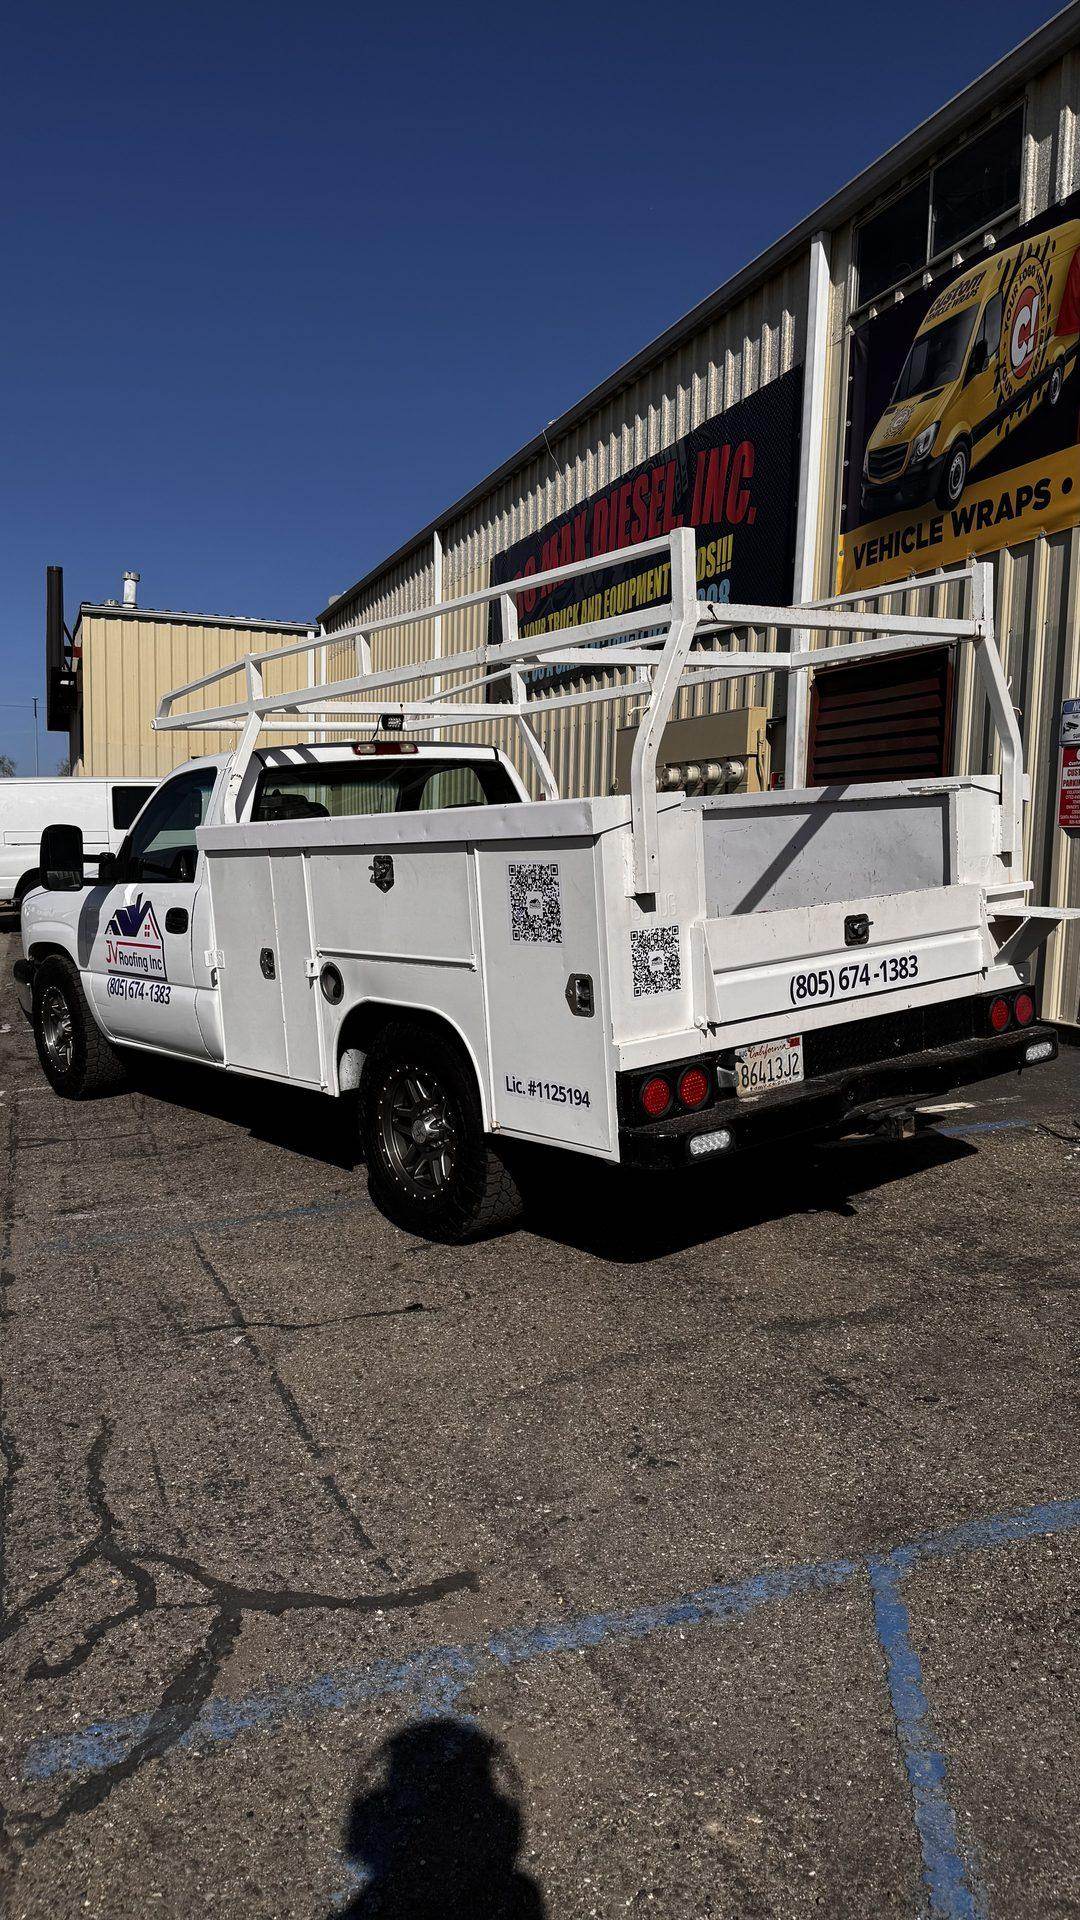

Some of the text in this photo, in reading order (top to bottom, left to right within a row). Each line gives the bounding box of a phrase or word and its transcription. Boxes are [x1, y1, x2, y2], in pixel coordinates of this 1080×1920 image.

[1004, 284, 1019, 332] YOUR
[1019, 264, 1036, 286] LOGO
[541, 508, 588, 597] MAX
[690, 440, 757, 526] INC.
[853, 476, 1052, 570] VEHICLE WRAPS
[547, 601, 580, 631] TRUCK
[580, 593, 602, 624] AND
[603, 562, 671, 617] EQUIPMENT
[105, 940, 163, 972] JV Roofing Inc
[106, 976, 128, 1000] (805)
[790, 968, 836, 1005] (805)
[748, 1044, 790, 1059] California
[741, 1052, 800, 1088] 86413J2
[505, 1074, 591, 1108] Lic. #1125194
